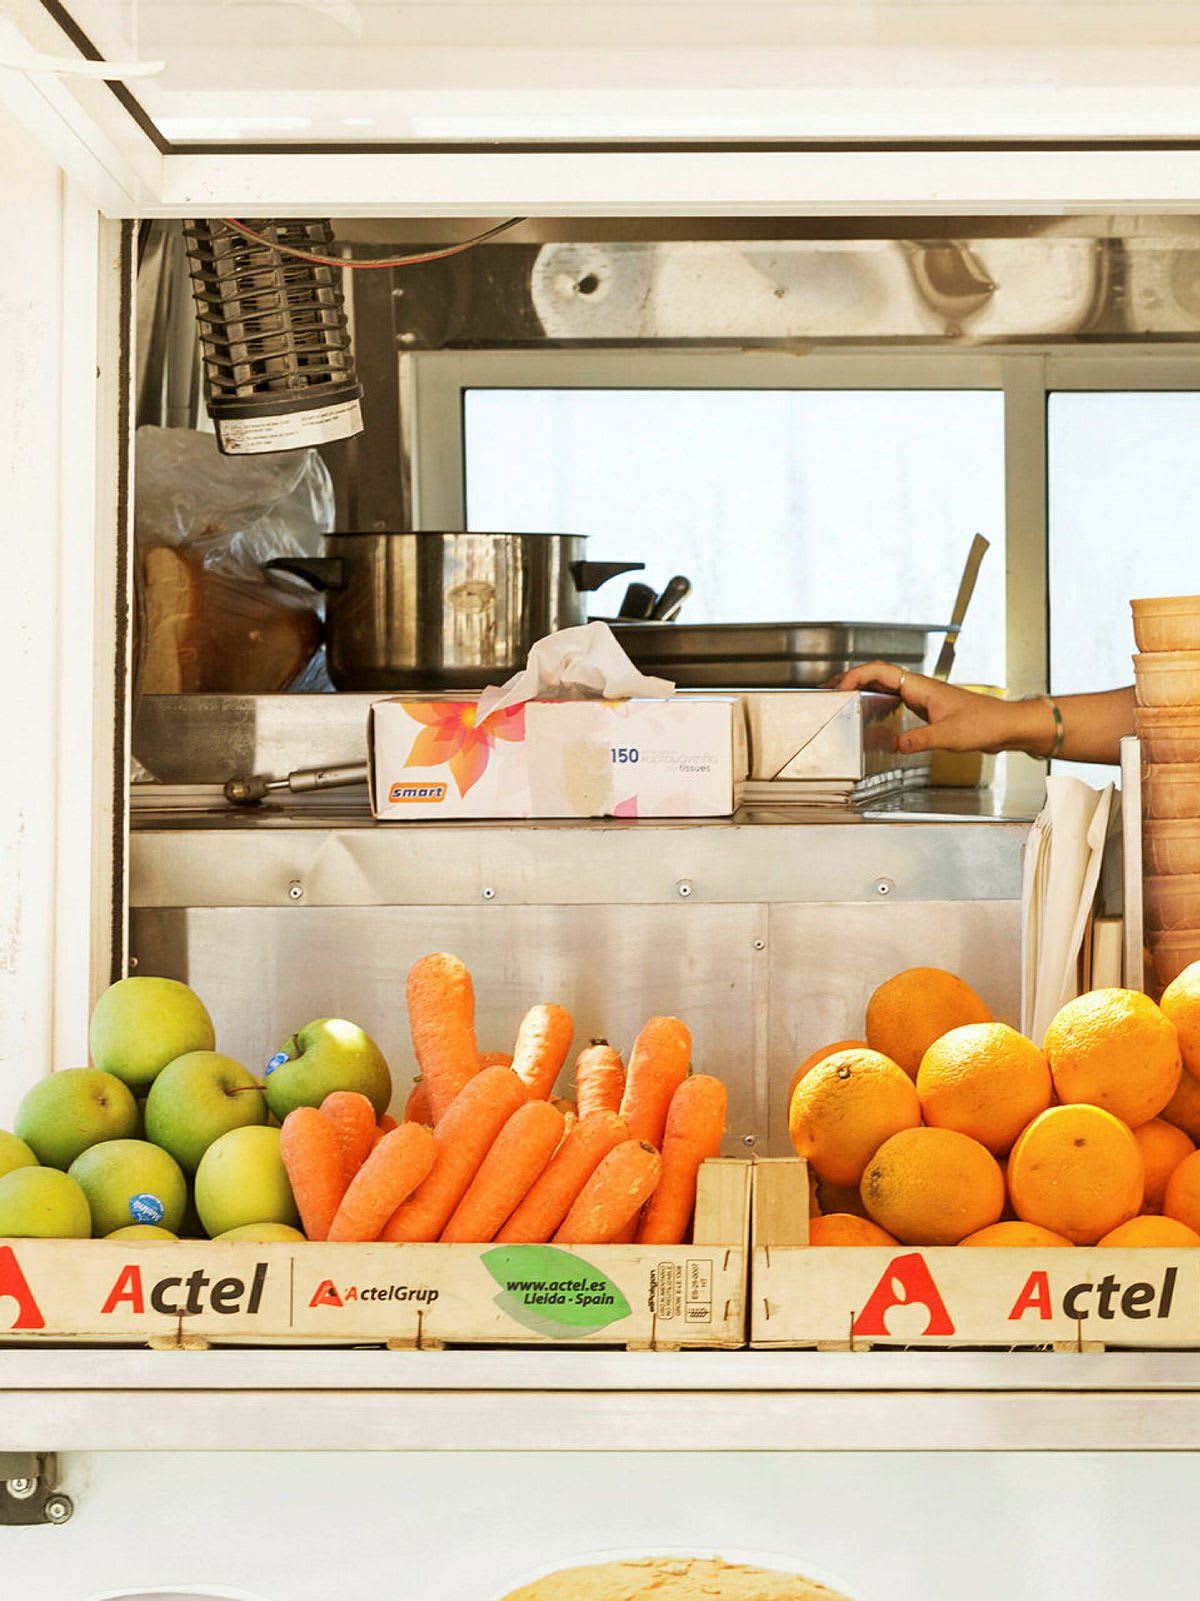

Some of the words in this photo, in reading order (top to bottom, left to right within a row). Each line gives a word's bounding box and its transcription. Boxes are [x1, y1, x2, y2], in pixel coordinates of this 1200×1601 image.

[611, 748, 639, 763] 150
[679, 764, 711, 773] tissues
[392, 787, 442, 798] smart
[100, 1263, 268, 1315] Actel
[506, 1279, 607, 1291] www.actel.es
[345, 1285, 439, 1305] ActelGrup
[524, 1293, 566, 1305] Lleida
[575, 1293, 615, 1307] Spain
[1008, 1267, 1178, 1320] Actel
